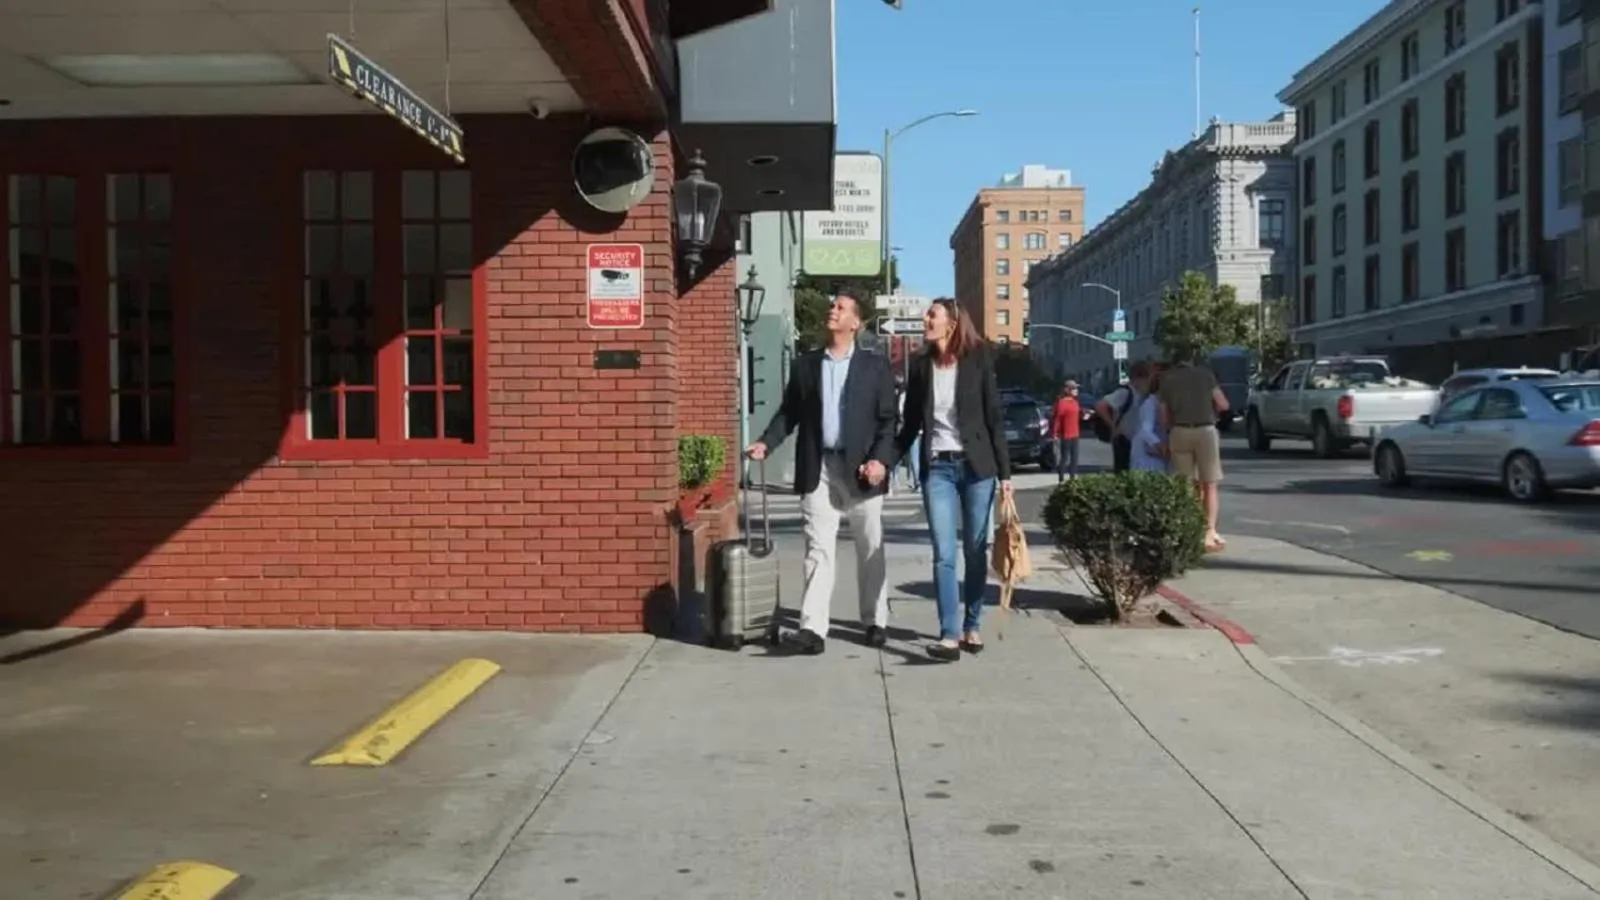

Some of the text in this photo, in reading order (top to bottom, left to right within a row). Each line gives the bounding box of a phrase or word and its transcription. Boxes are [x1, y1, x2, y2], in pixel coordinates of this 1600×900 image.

[356, 65, 422, 125] CLEARANCE
[594, 252, 636, 260] SECURITY
[599, 259, 631, 267] NOTICE
